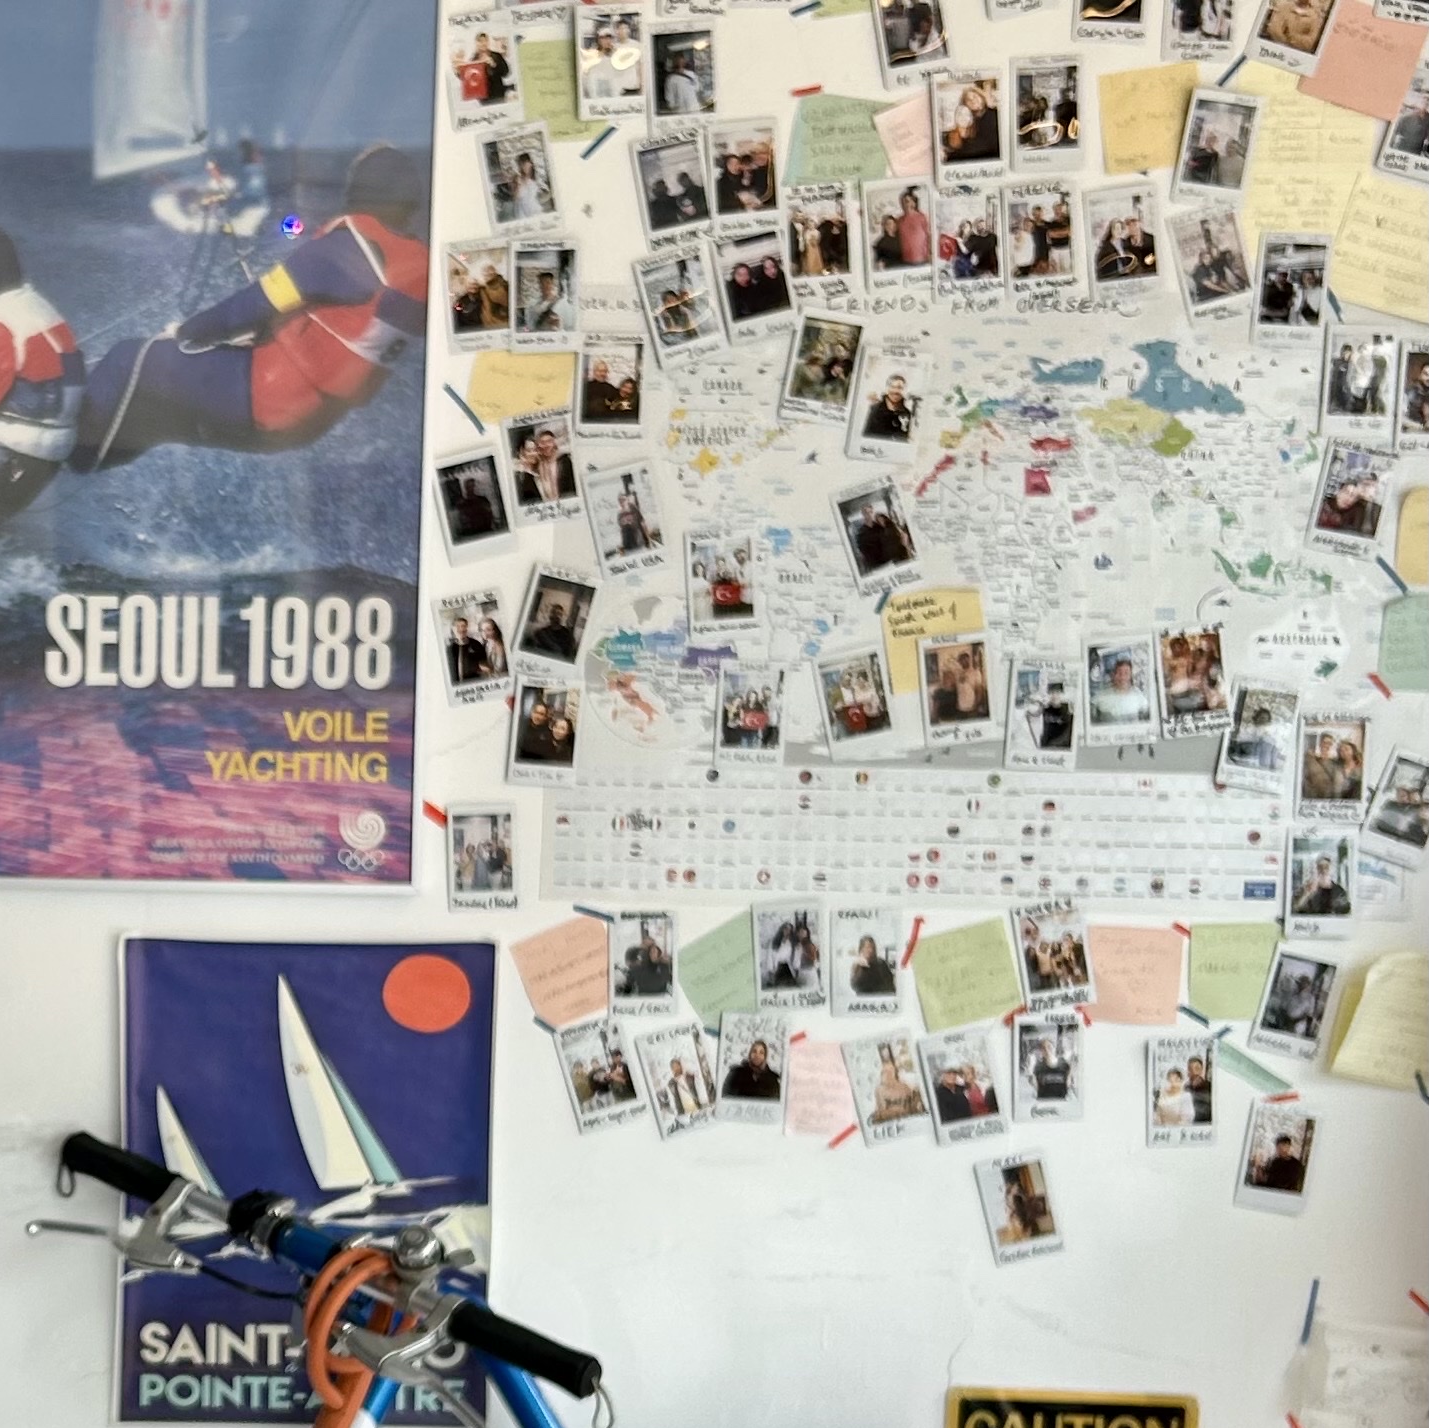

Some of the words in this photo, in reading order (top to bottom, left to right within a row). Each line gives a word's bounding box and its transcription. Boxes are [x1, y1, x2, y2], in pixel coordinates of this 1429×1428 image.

[45, 593, 236, 690] SEOUL
[239, 597, 394, 691] 1988
[282, 710, 389, 743] VOILE
[204, 751, 388, 783] YACHTING
